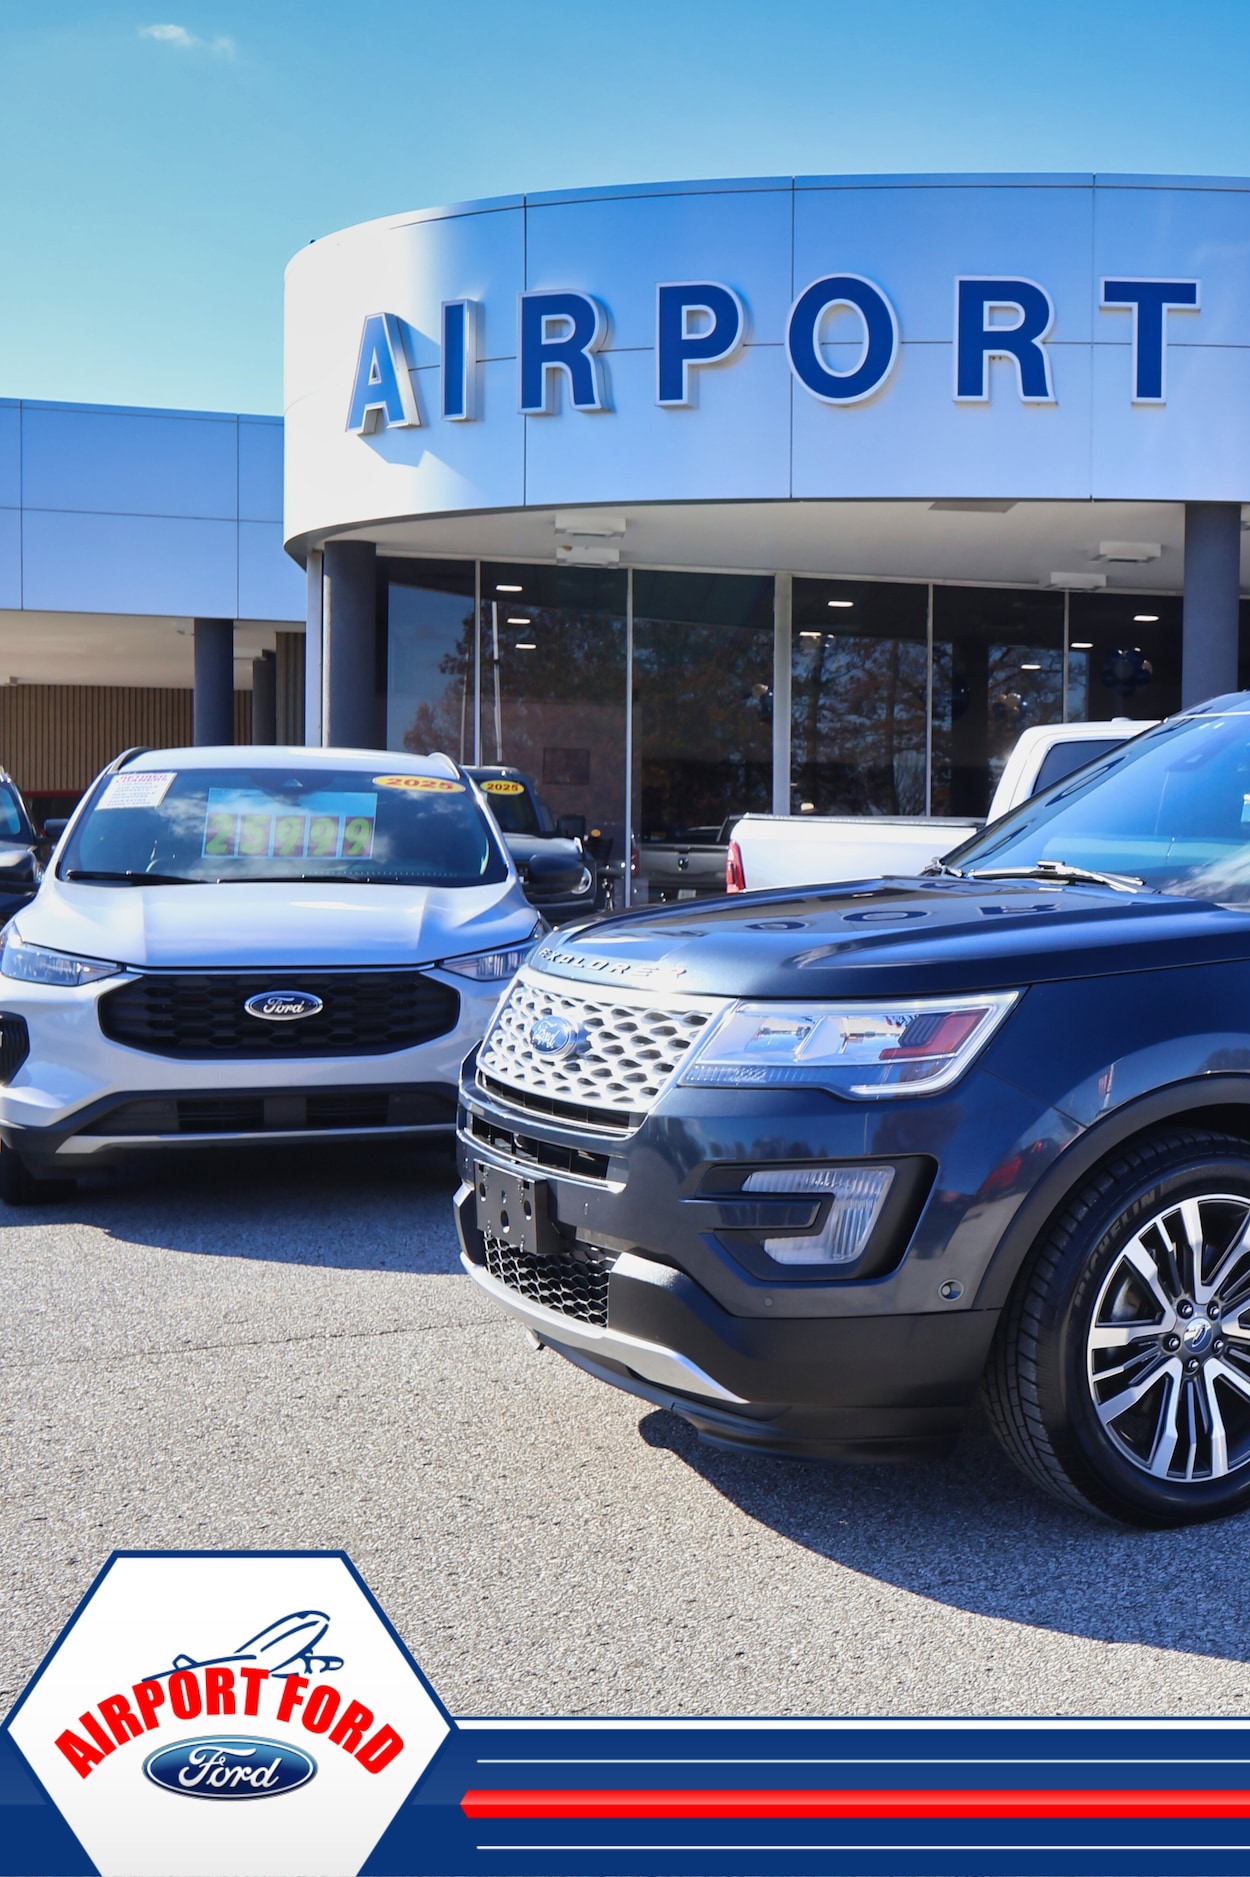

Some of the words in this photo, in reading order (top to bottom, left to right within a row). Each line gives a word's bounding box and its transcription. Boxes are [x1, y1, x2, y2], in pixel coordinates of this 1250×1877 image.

[345, 273, 1201, 434] AIRPORT
[385, 778, 454, 790] 2025
[486, 782, 520, 792] 2025
[205, 813, 371, 856] 25999
[263, 996, 305, 1014] Ford
